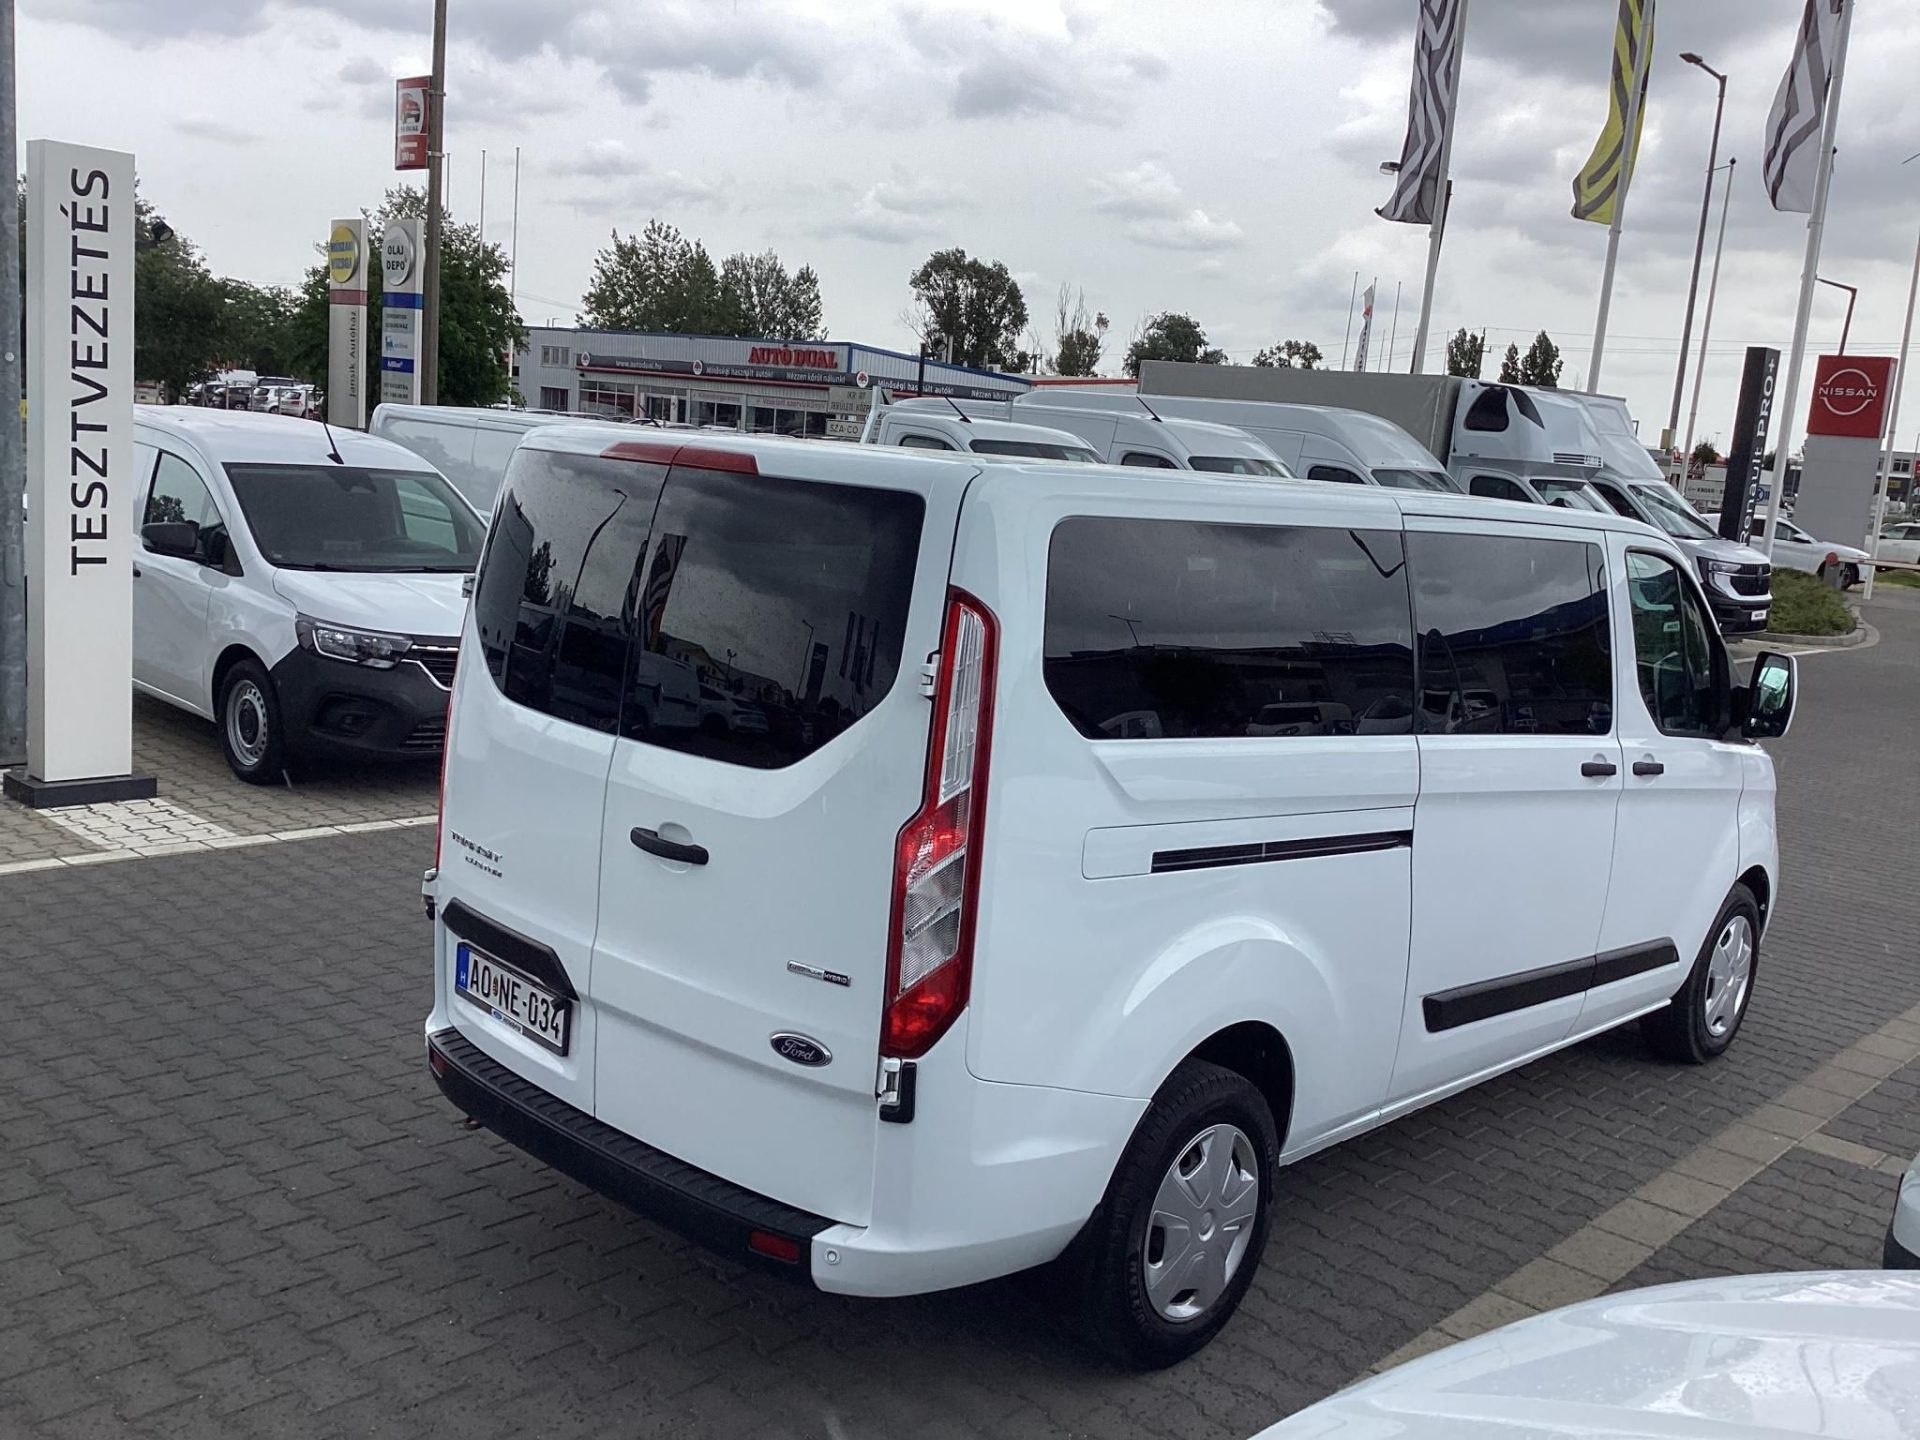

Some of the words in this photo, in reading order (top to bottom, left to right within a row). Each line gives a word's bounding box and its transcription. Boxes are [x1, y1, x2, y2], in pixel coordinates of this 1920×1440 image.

[387, 245, 404, 255] OLAJ
[386, 260, 405, 270] DEPO
[748, 343, 793, 365] AUTÓ
[793, 350, 838, 369] DUAL
[60, 168, 110, 576] TESZTVEZETÉS
[878, 379, 907, 391] Minőségi
[1818, 386, 1878, 397] NISSAN
[1739, 446, 1764, 547] Renault
[1757, 358, 1776, 437] PRO+
[460, 971, 466, 984] H
[470, 958, 492, 999] AO
[780, 1038, 816, 1061] Ford
